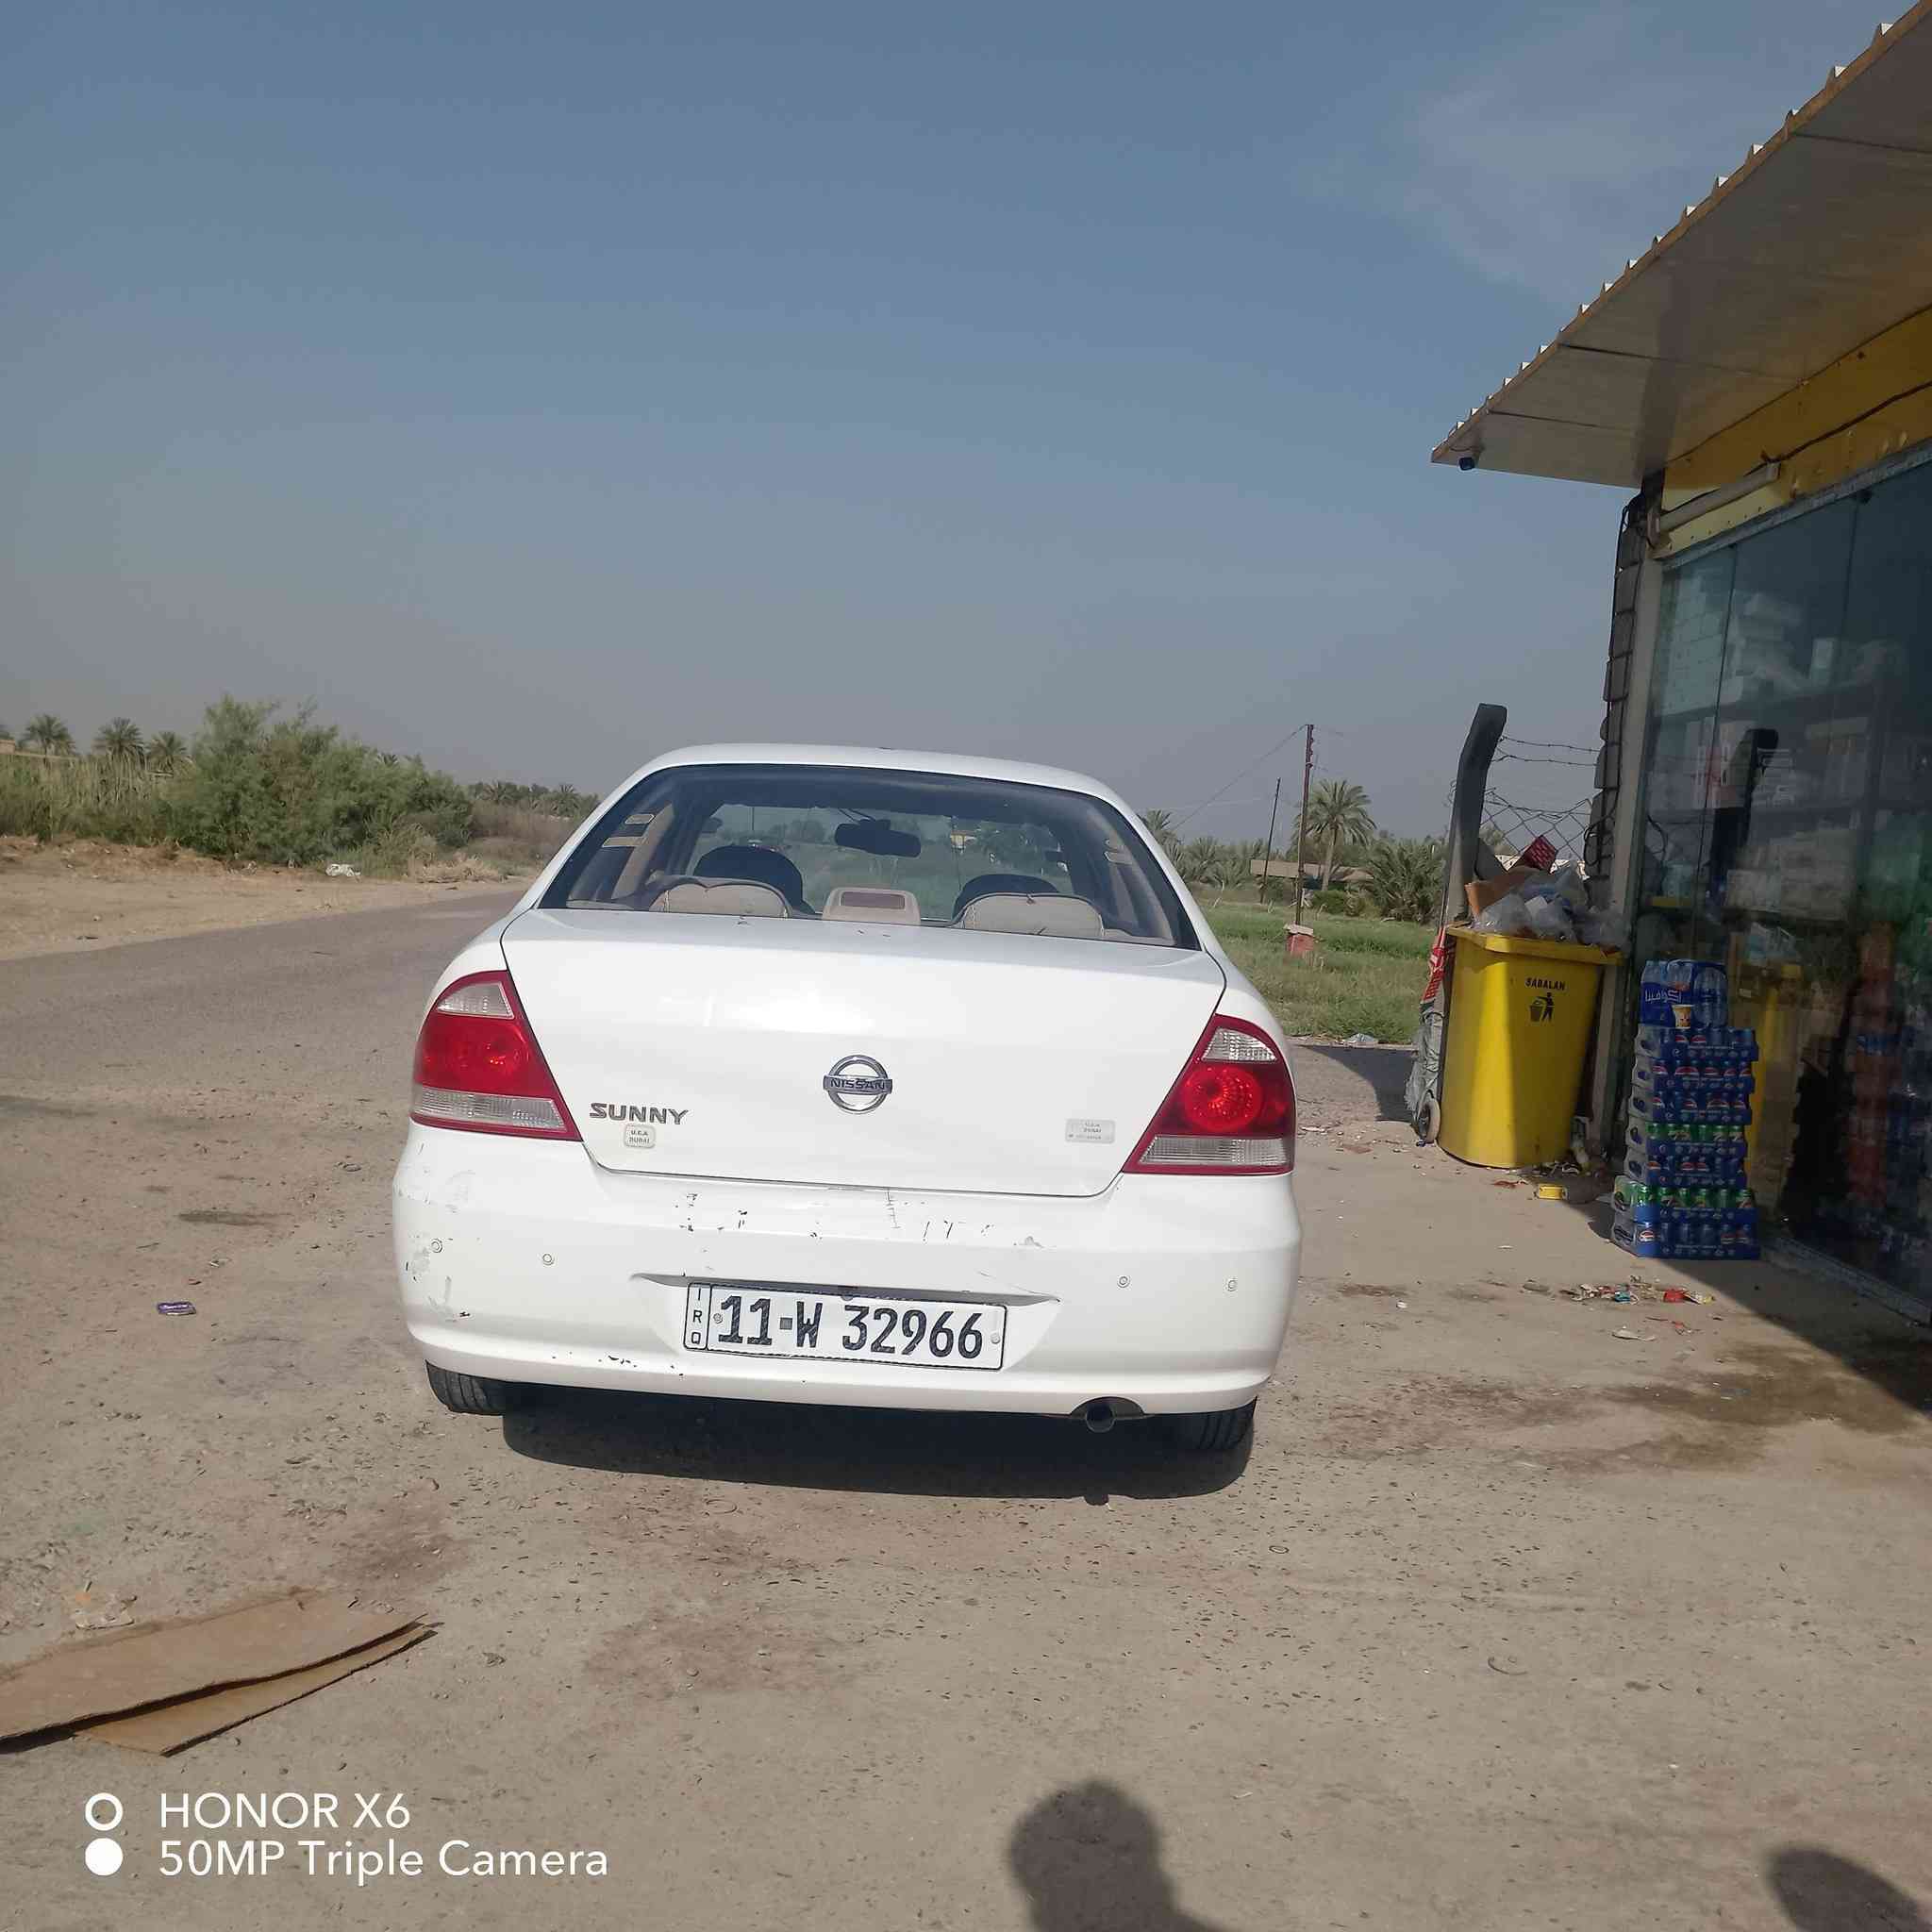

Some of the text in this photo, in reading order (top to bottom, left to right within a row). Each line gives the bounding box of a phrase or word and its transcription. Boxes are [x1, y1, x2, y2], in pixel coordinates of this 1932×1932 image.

[830, 1077, 885, 1091] NISSAN
[589, 1102, 690, 1125] SUNNY
[841, 1304, 983, 1360] 32966
